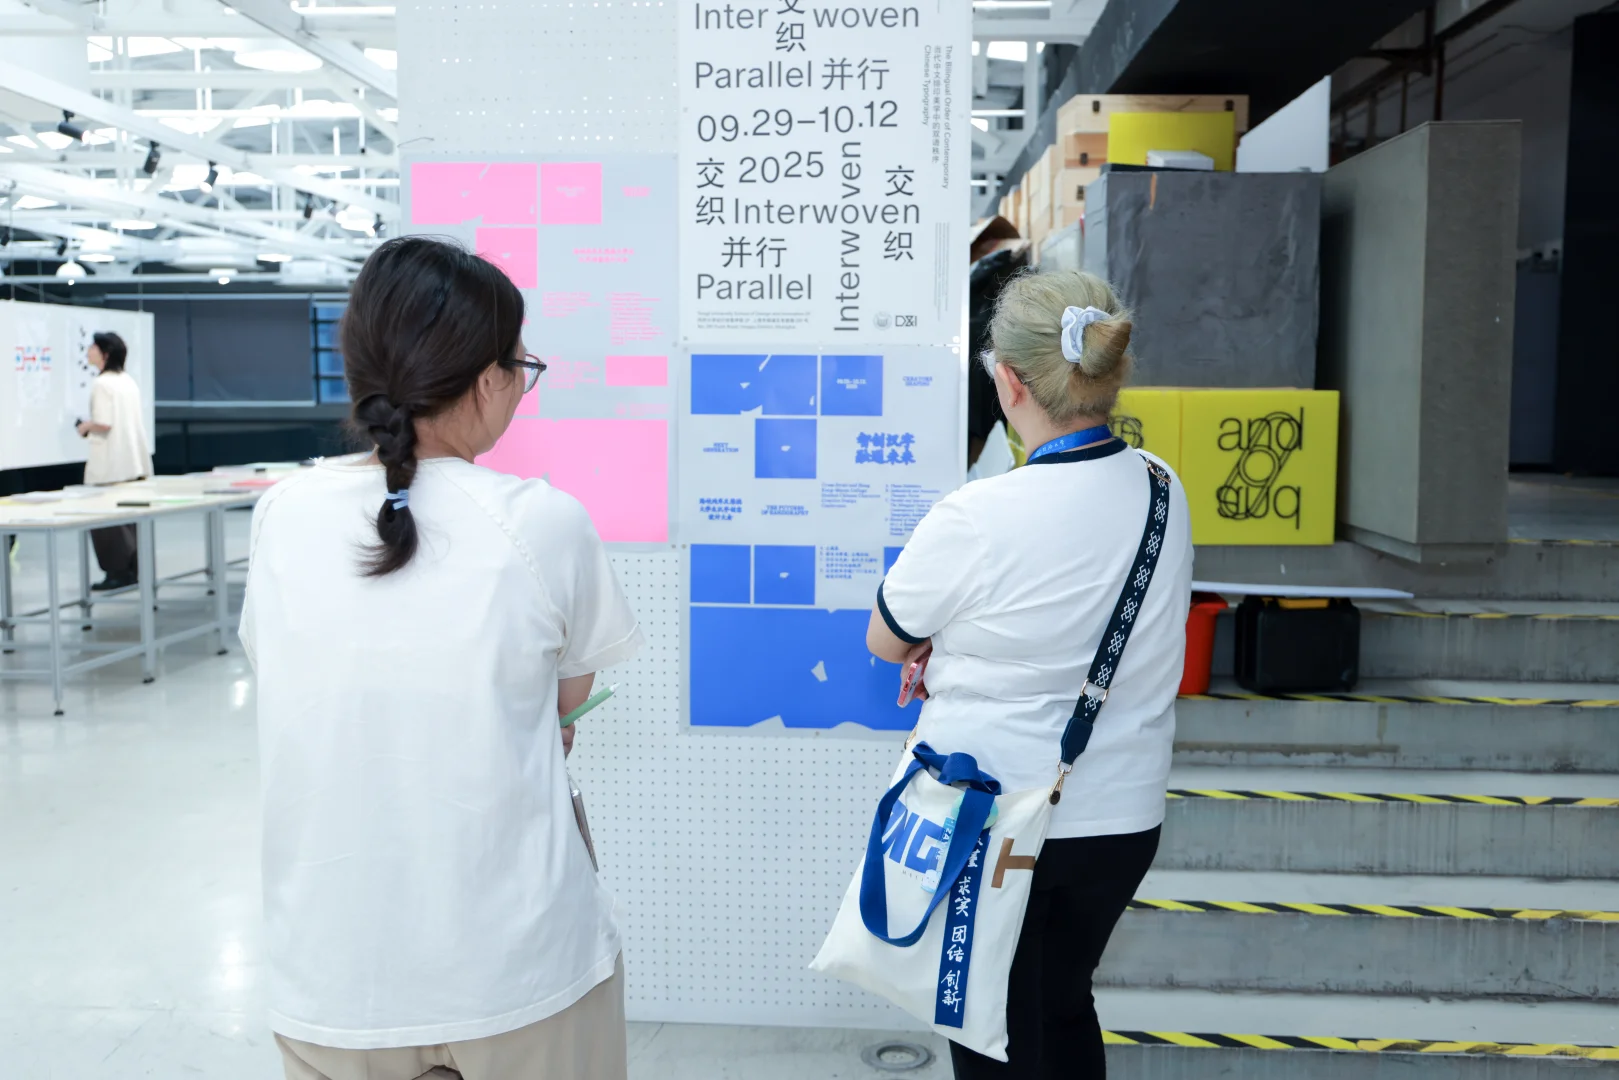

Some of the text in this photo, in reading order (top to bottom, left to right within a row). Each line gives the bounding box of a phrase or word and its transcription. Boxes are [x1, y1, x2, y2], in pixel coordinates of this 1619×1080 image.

[695, 3, 919, 29] Inter woven
[696, 61, 812, 88] Parallel
[822, 58, 890, 90] 并行
[738, 151, 824, 184] 2025
[734, 198, 920, 224] Interwoven
[722, 236, 788, 268] 并行
[834, 141, 862, 331] Interwoven
[697, 274, 812, 300] Parallel
[947, 925, 967, 963] 团结
[940, 970, 963, 1013] 创新
